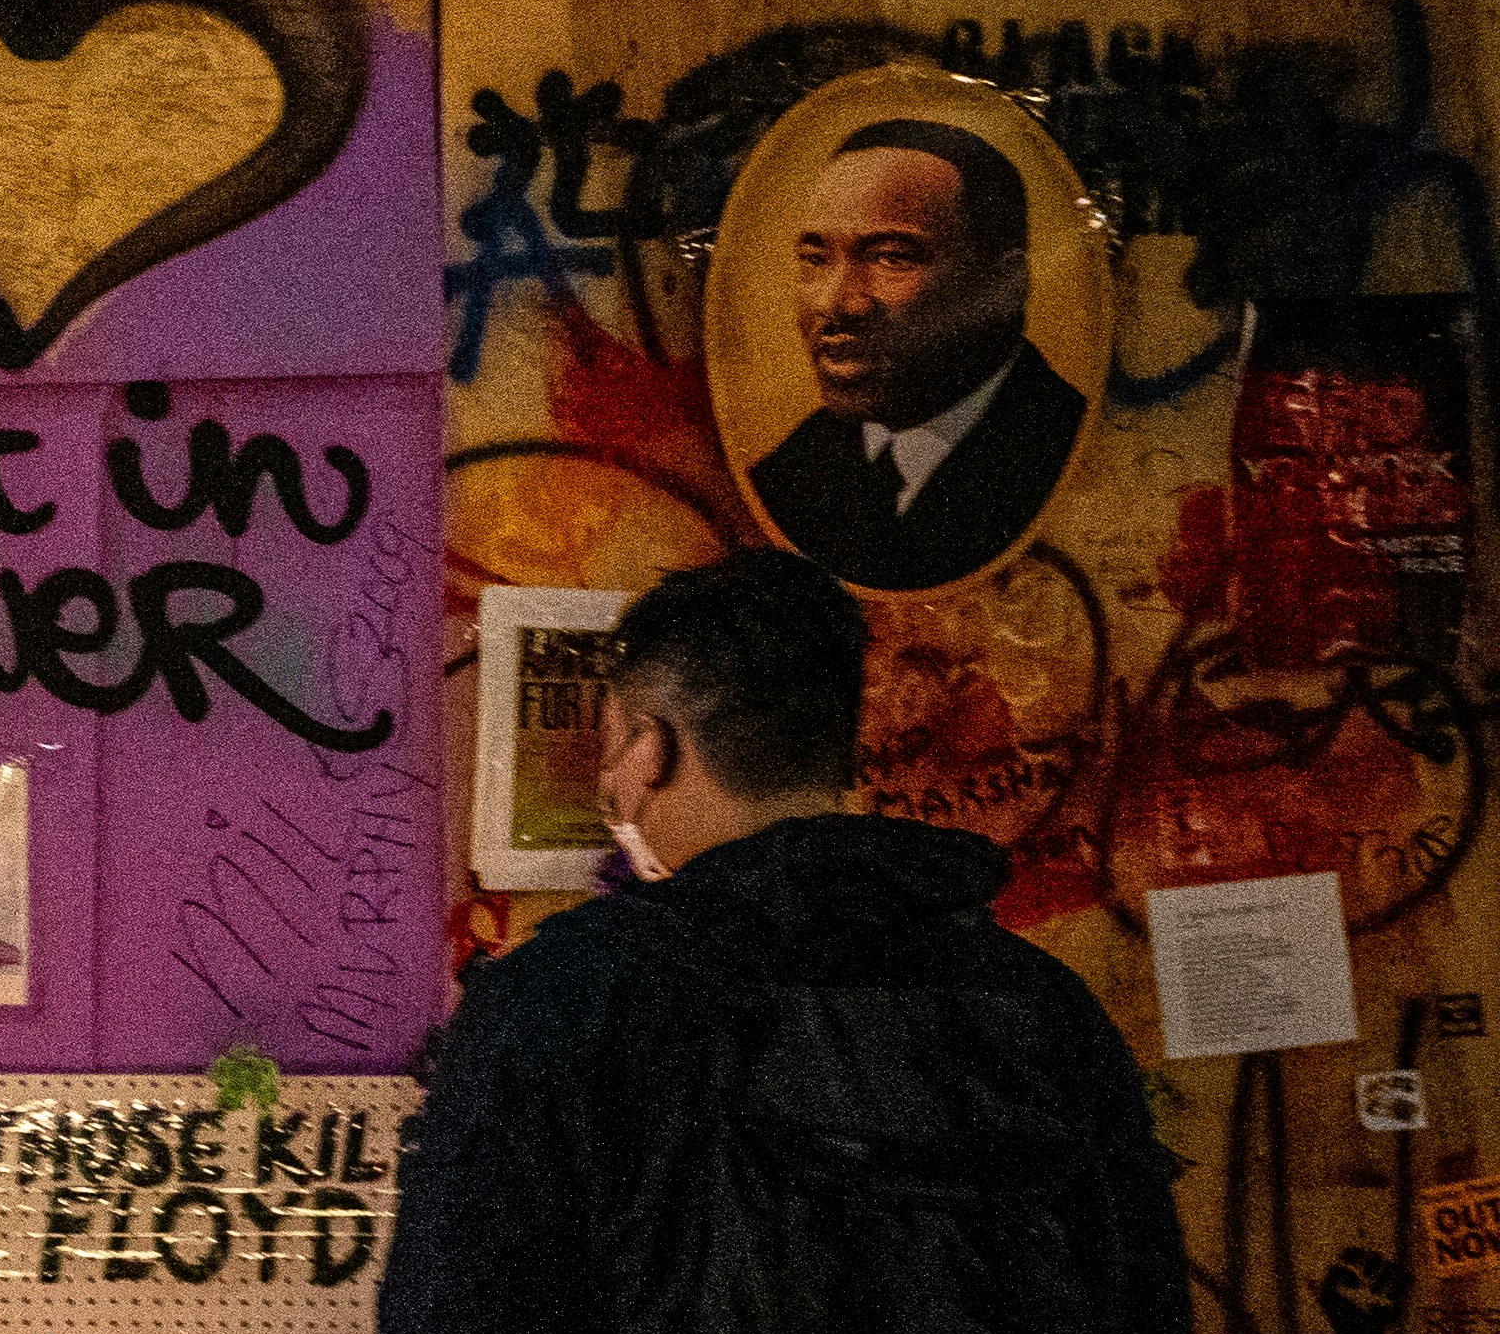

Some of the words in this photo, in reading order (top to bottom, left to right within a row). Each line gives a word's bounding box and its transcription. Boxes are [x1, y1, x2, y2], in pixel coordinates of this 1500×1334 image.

[108, 380, 370, 545] in
[255, 1110, 384, 1187] KIL
[39, 1185, 374, 1286] FLOYD
